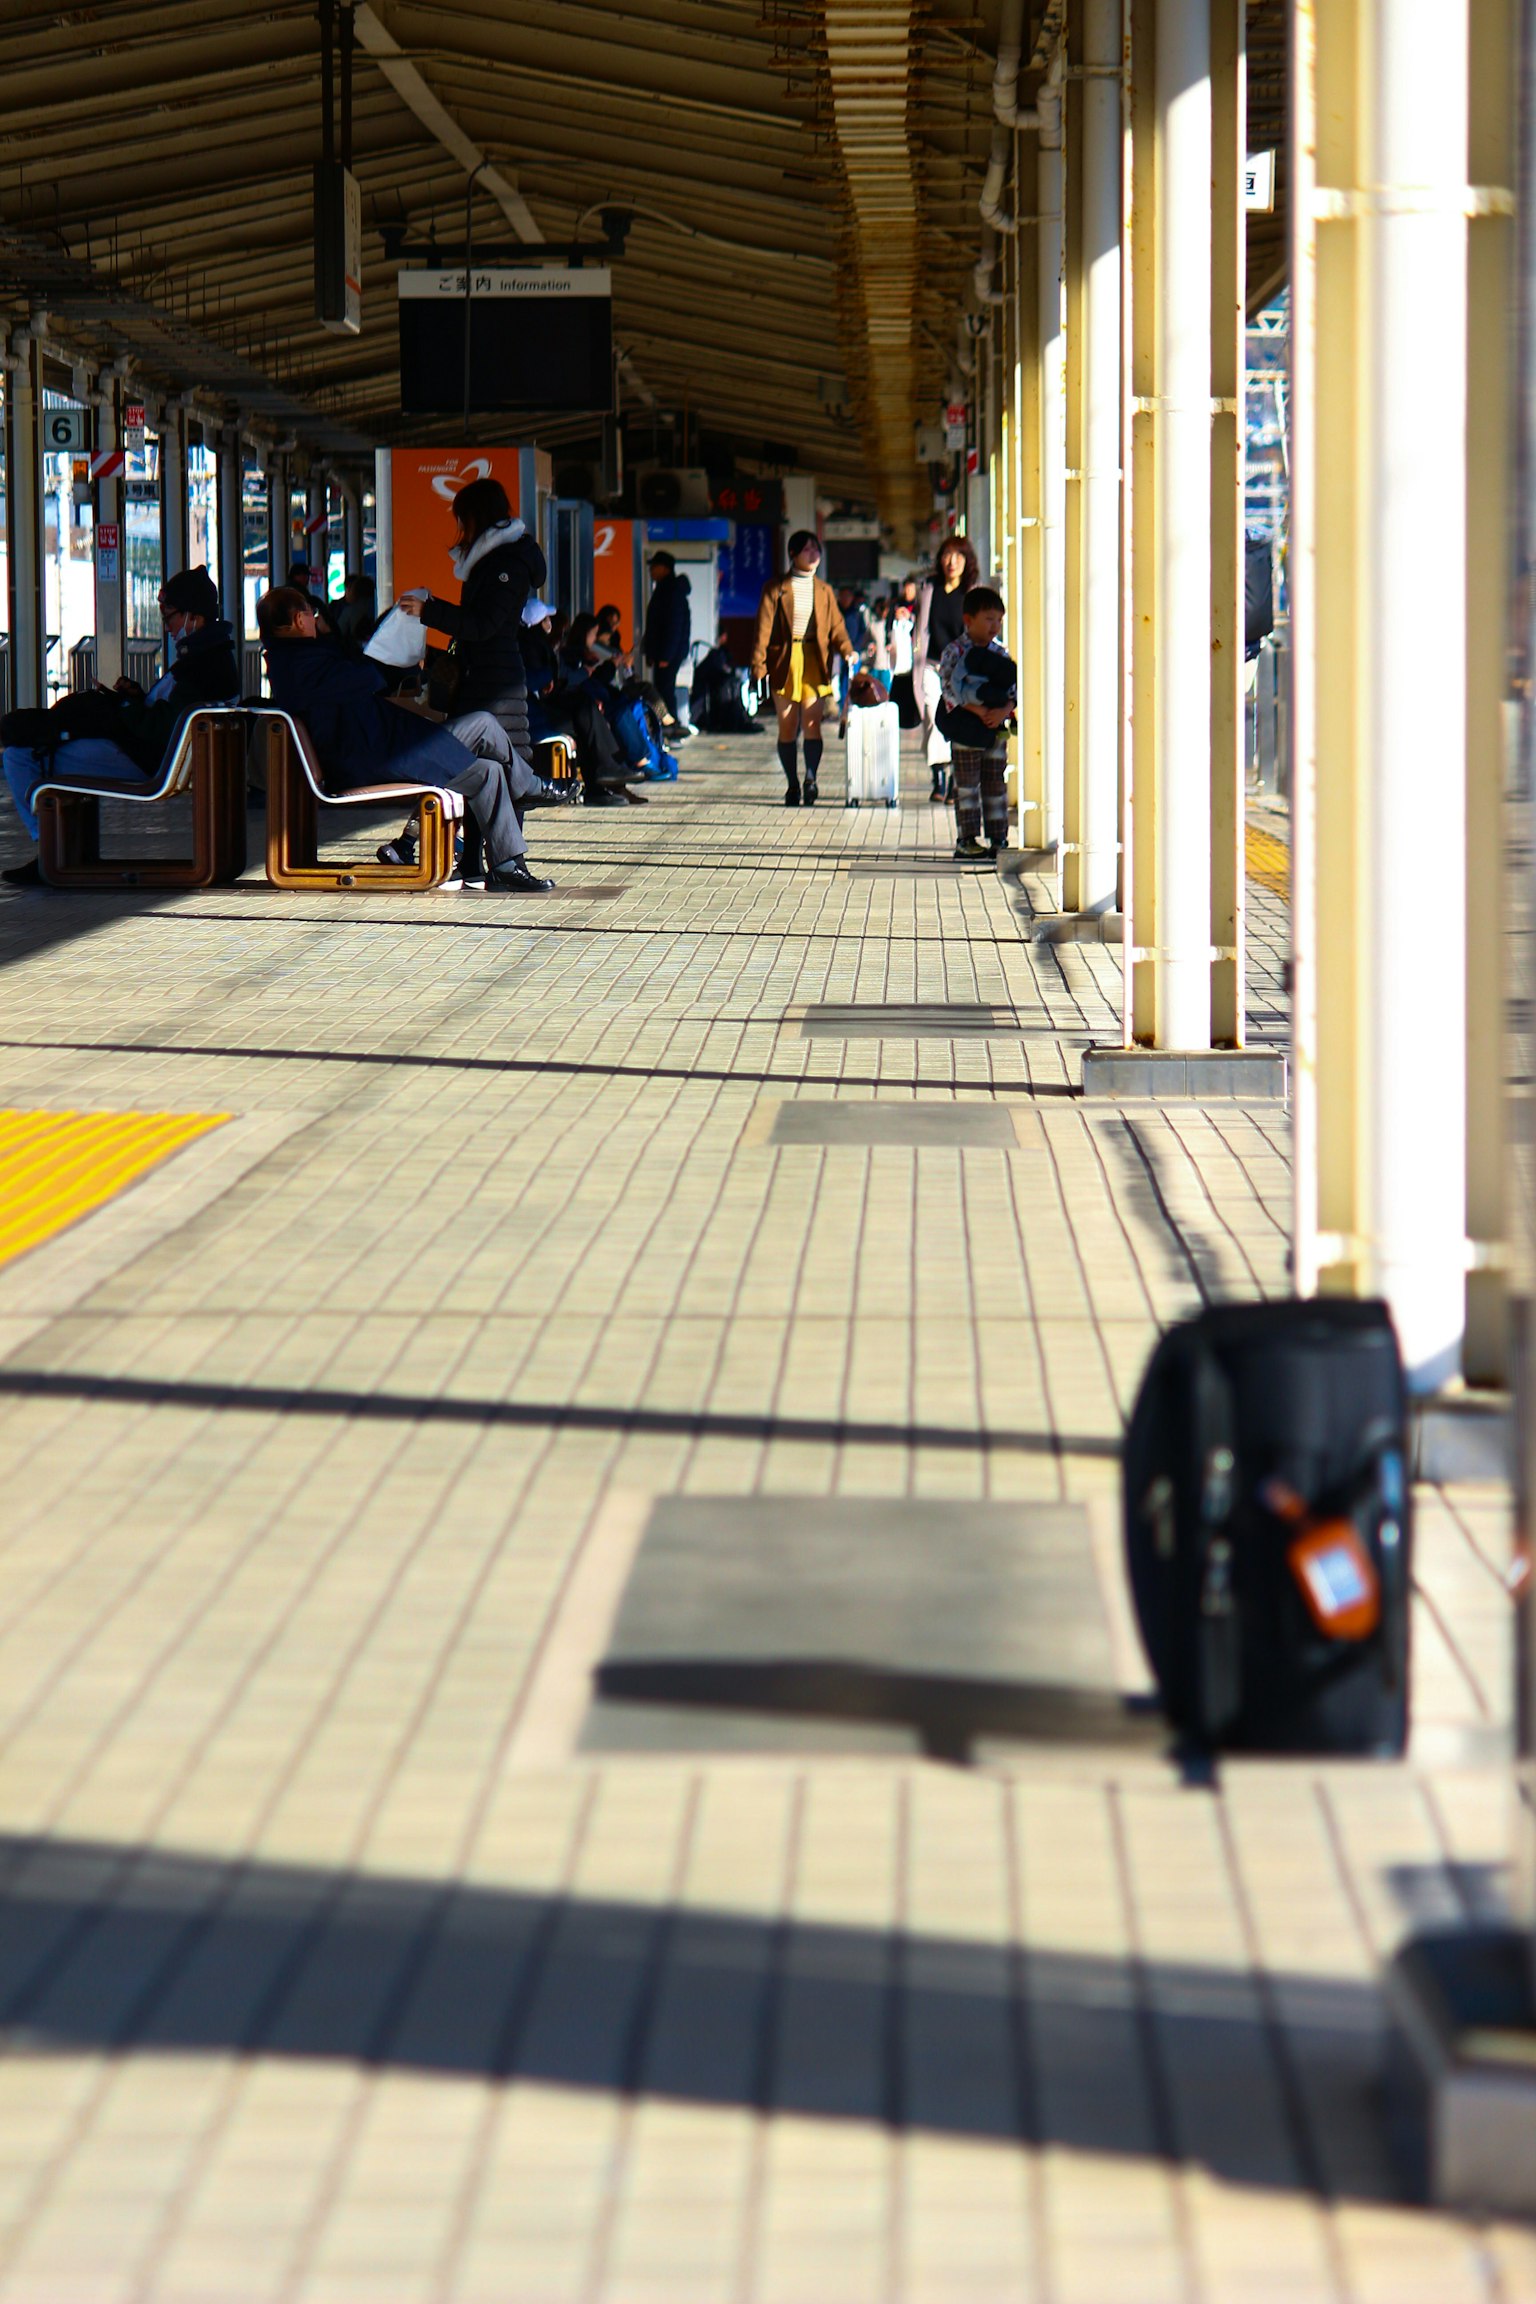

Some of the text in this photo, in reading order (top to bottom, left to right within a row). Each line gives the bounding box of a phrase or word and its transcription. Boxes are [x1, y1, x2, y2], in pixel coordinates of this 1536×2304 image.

[439, 275, 491, 291] ご案内
[500, 278, 571, 291] Information
[52, 417, 73, 444] 6
